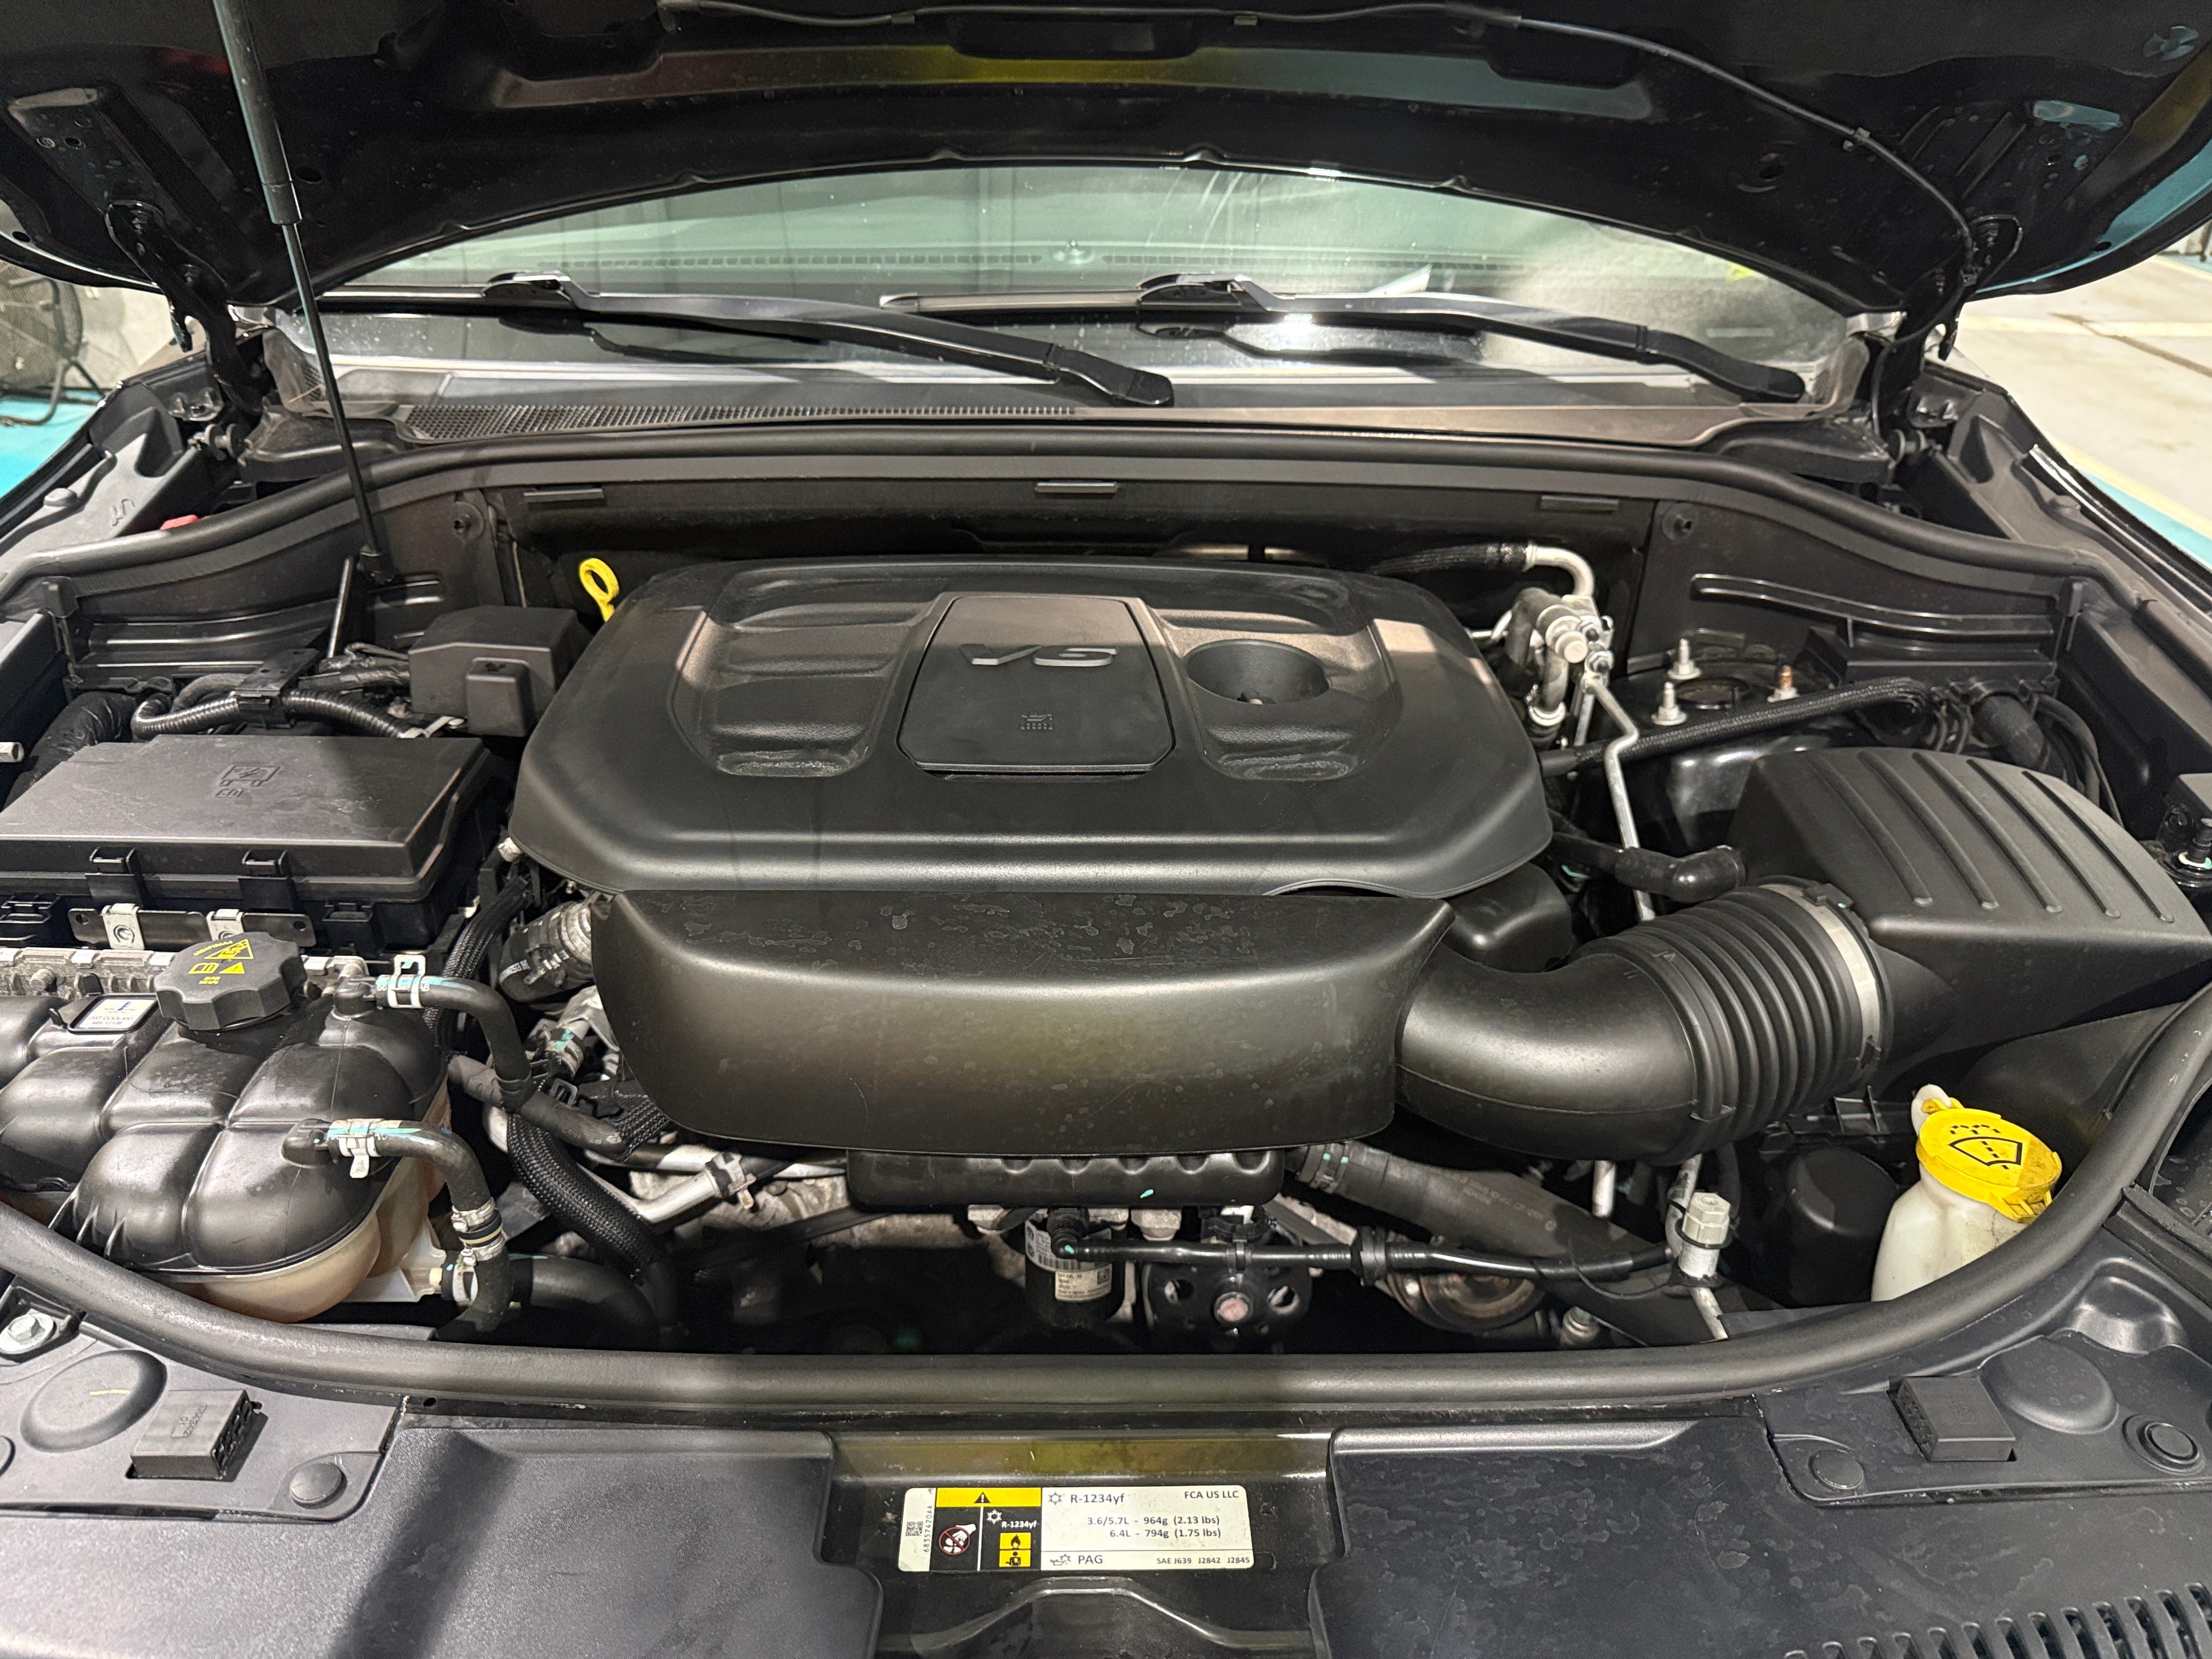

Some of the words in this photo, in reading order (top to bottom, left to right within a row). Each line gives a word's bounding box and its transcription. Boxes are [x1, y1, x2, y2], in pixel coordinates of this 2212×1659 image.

[1070, 1493, 1125, 1505] R-1234yf
[1001, 1520, 1037, 1530] R-1234yf
[1087, 1516, 1130, 1527] 3.6/5.7L
[1143, 1516, 1168, 1526] 964g
[1173, 1515, 1199, 1526] (2.13
[1201, 1515, 1220, 1526] lbs)
[923, 1505, 933, 1553] 68357420AA
[1144, 1529, 1170, 1539] 794g
[1175, 1528, 1200, 1539] (1.75
[1203, 1527, 1221, 1538] lbs)
[1078, 1555, 1103, 1565] PAG
